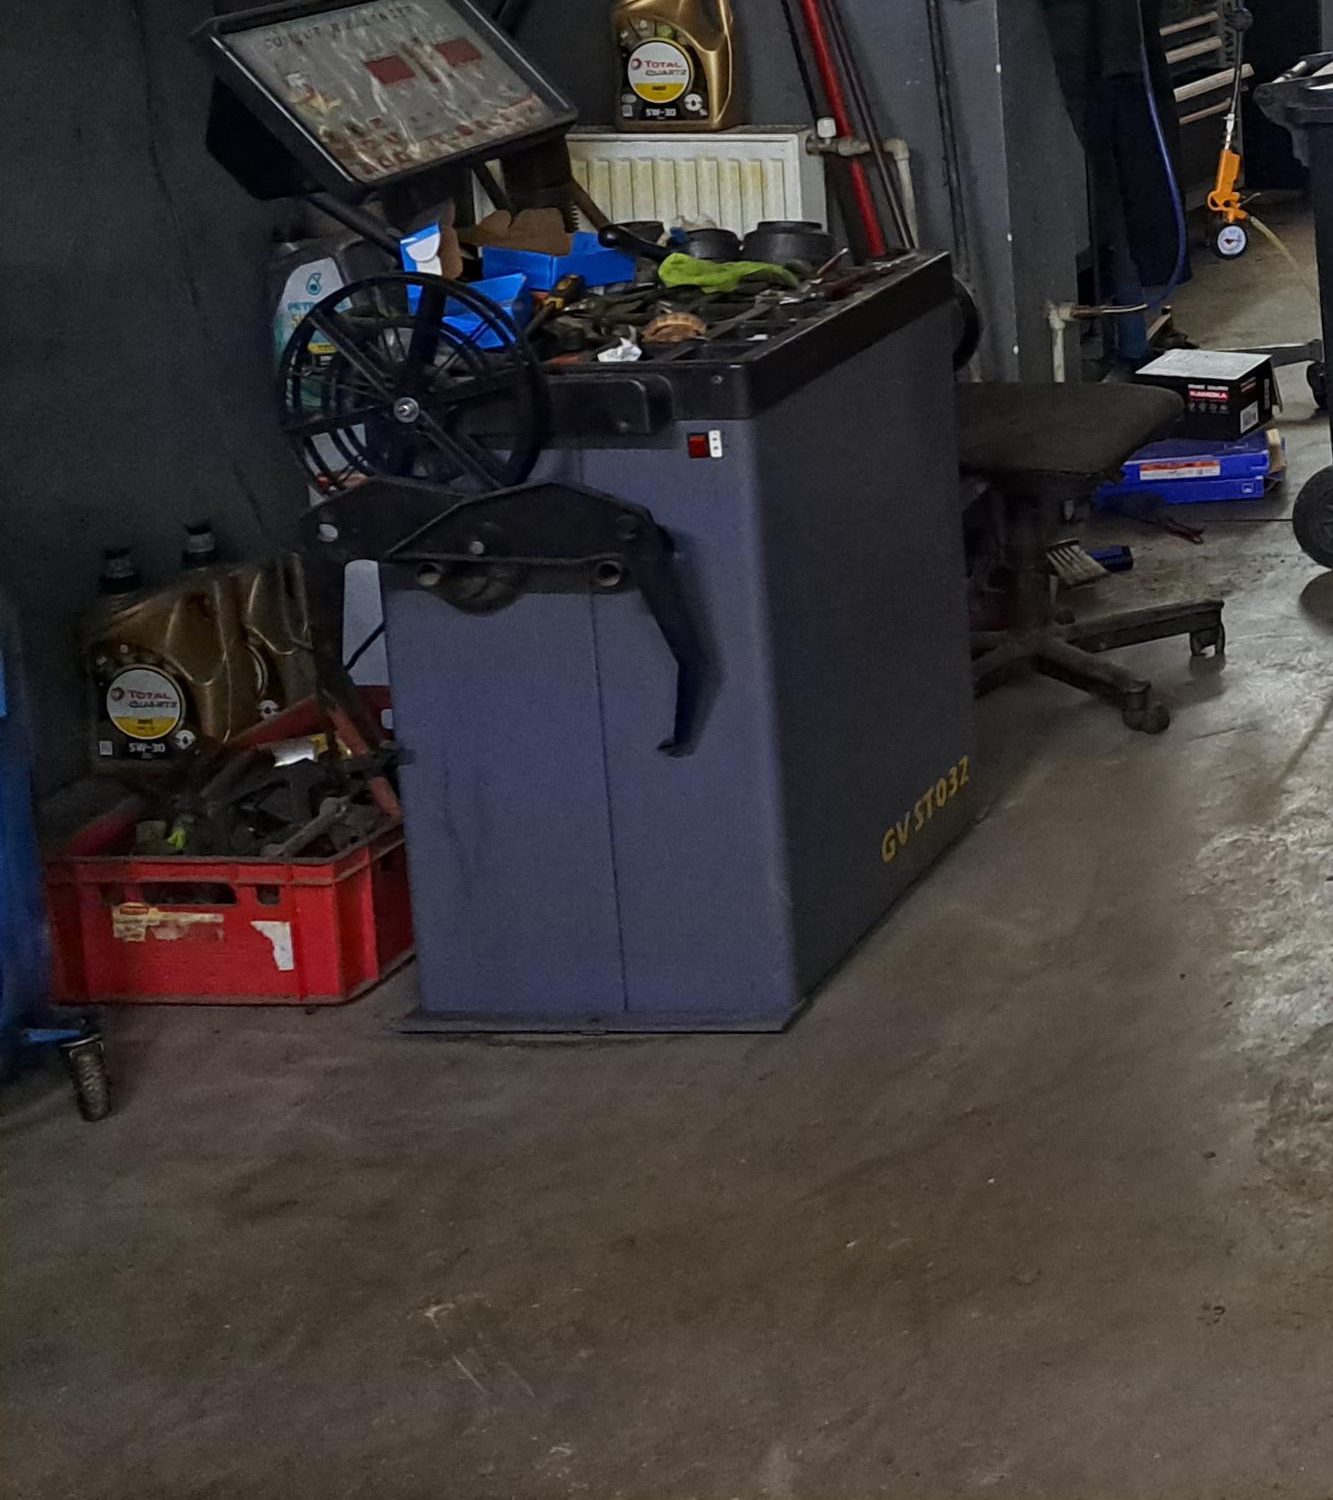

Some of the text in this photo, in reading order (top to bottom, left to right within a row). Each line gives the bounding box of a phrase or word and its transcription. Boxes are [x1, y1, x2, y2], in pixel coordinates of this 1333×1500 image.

[644, 59, 682, 69] TOTAL
[127, 689, 172, 700] TOTAL
[128, 742, 166, 754] 5W-30
